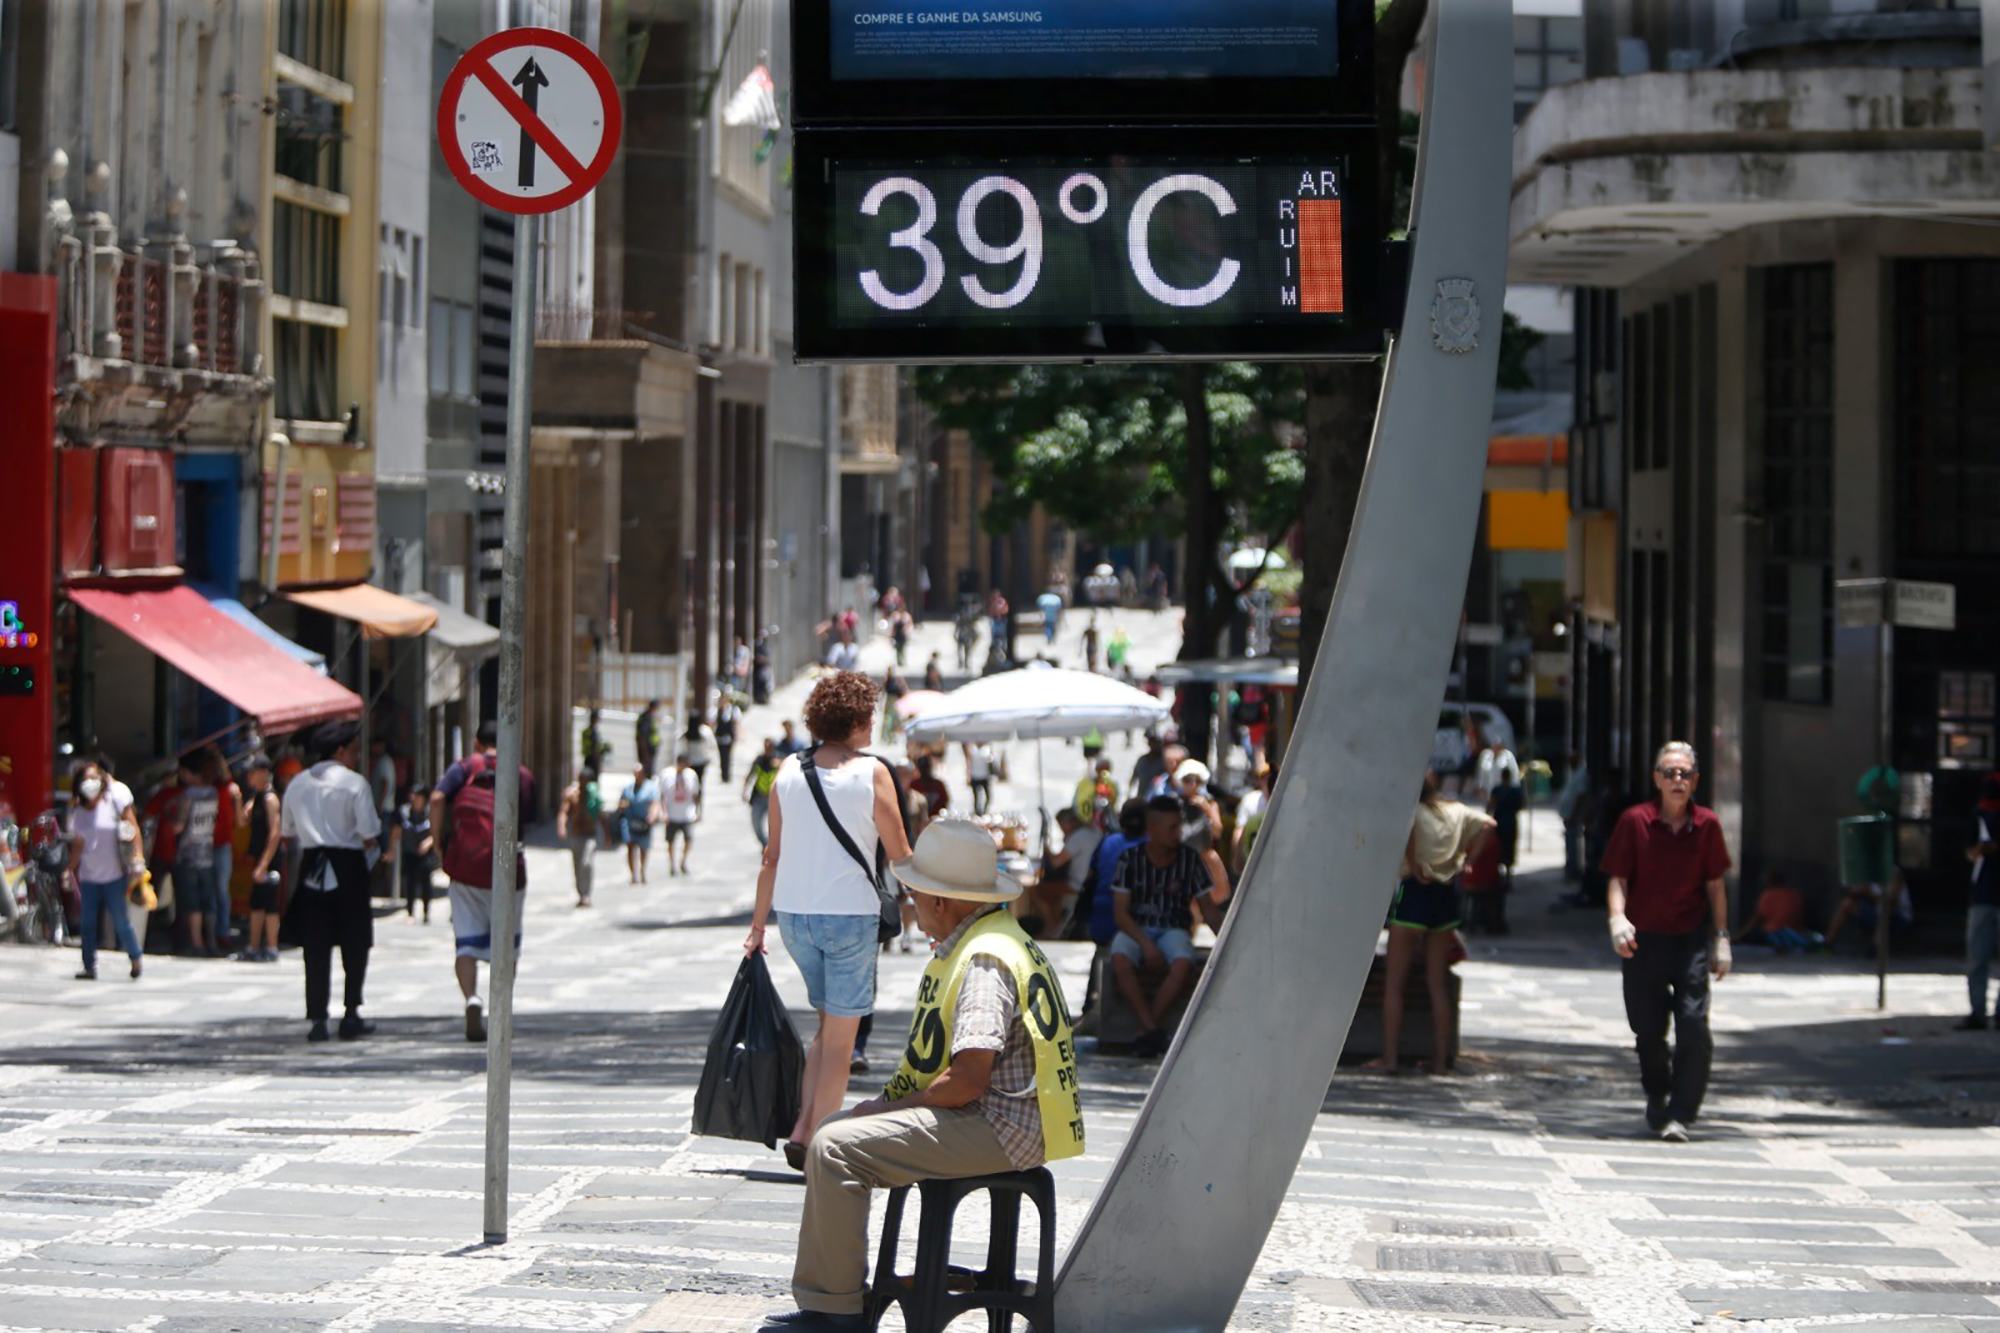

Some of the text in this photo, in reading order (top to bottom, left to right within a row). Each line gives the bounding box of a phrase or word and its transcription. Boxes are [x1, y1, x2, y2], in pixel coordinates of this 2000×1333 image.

[854, 11, 1042, 24] COMPRE E GANHE DA SAMSUNG
[1298, 171, 1337, 196] AR
[858, 172, 1241, 310] 39°C
[1280, 200, 1297, 306] RUIM
